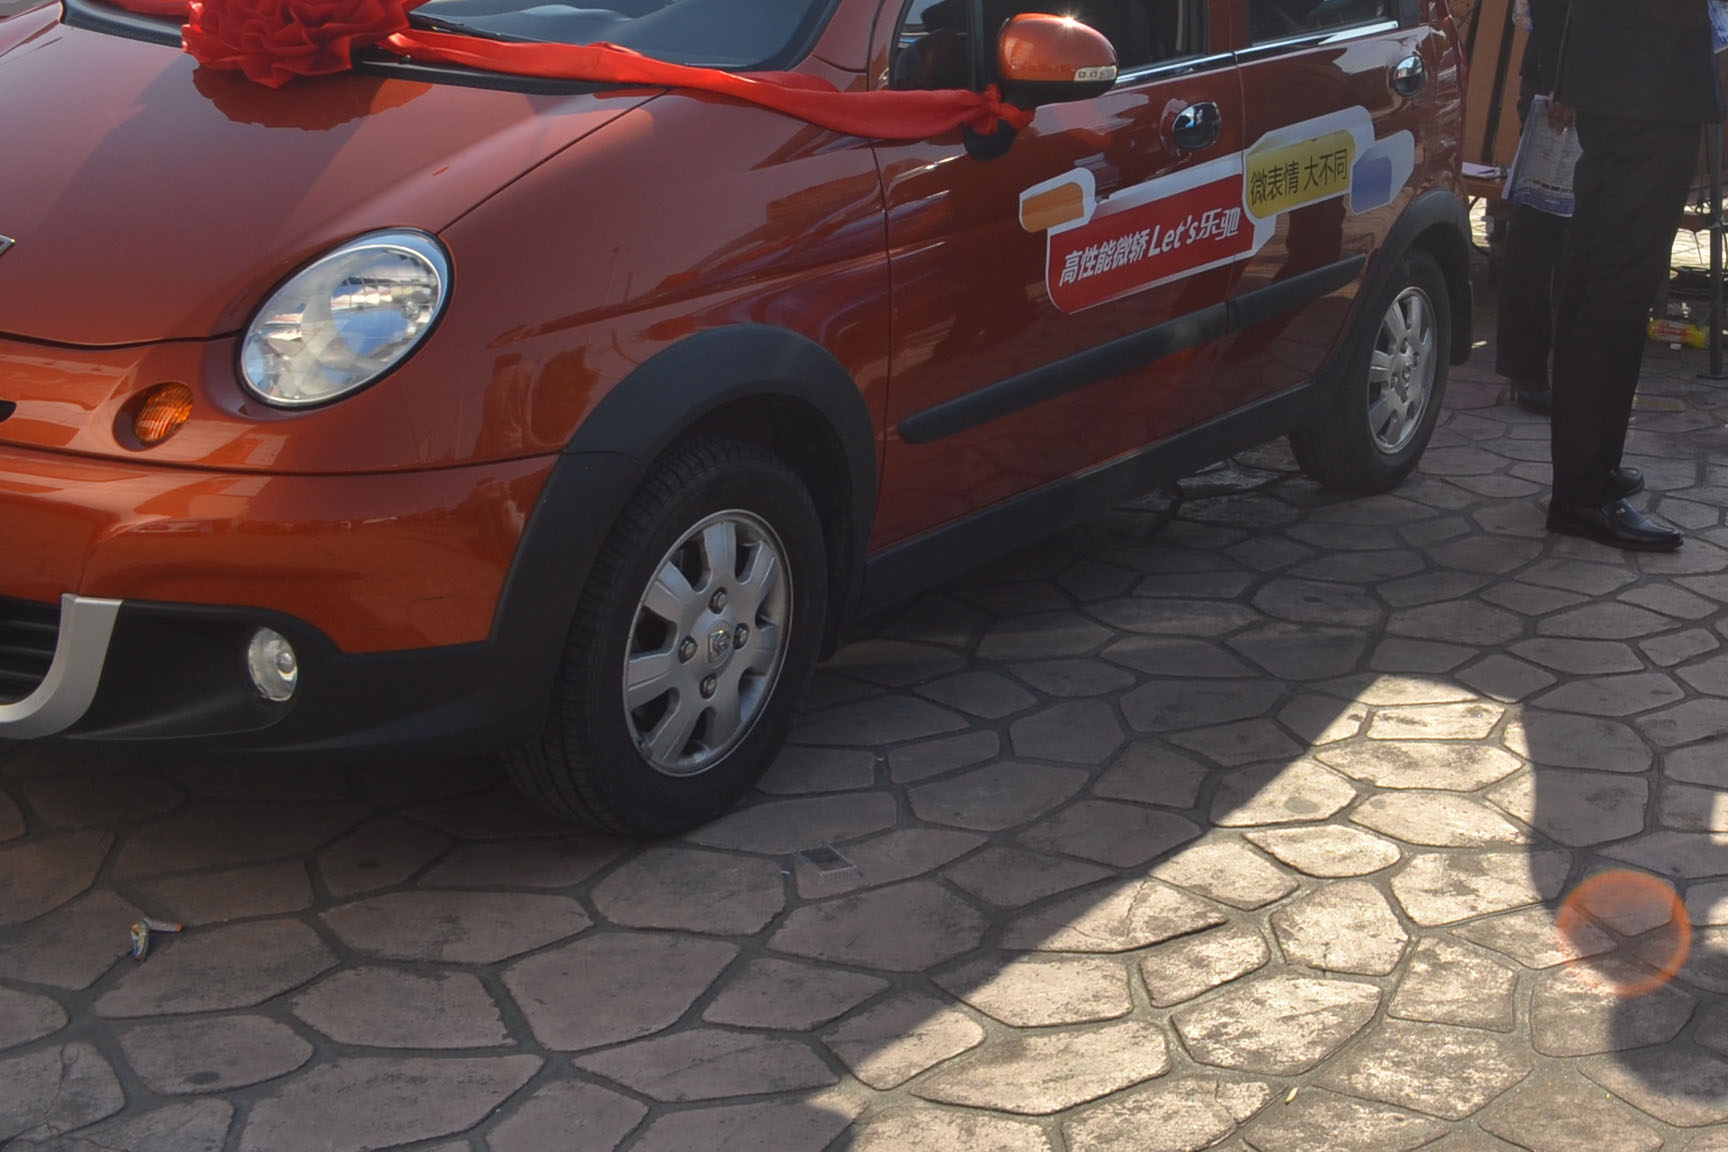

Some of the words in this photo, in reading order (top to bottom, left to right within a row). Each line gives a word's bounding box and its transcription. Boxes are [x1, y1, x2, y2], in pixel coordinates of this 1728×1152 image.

[1250, 161, 1300, 206] 微表情
[1304, 149, 1349, 190] 大不同
